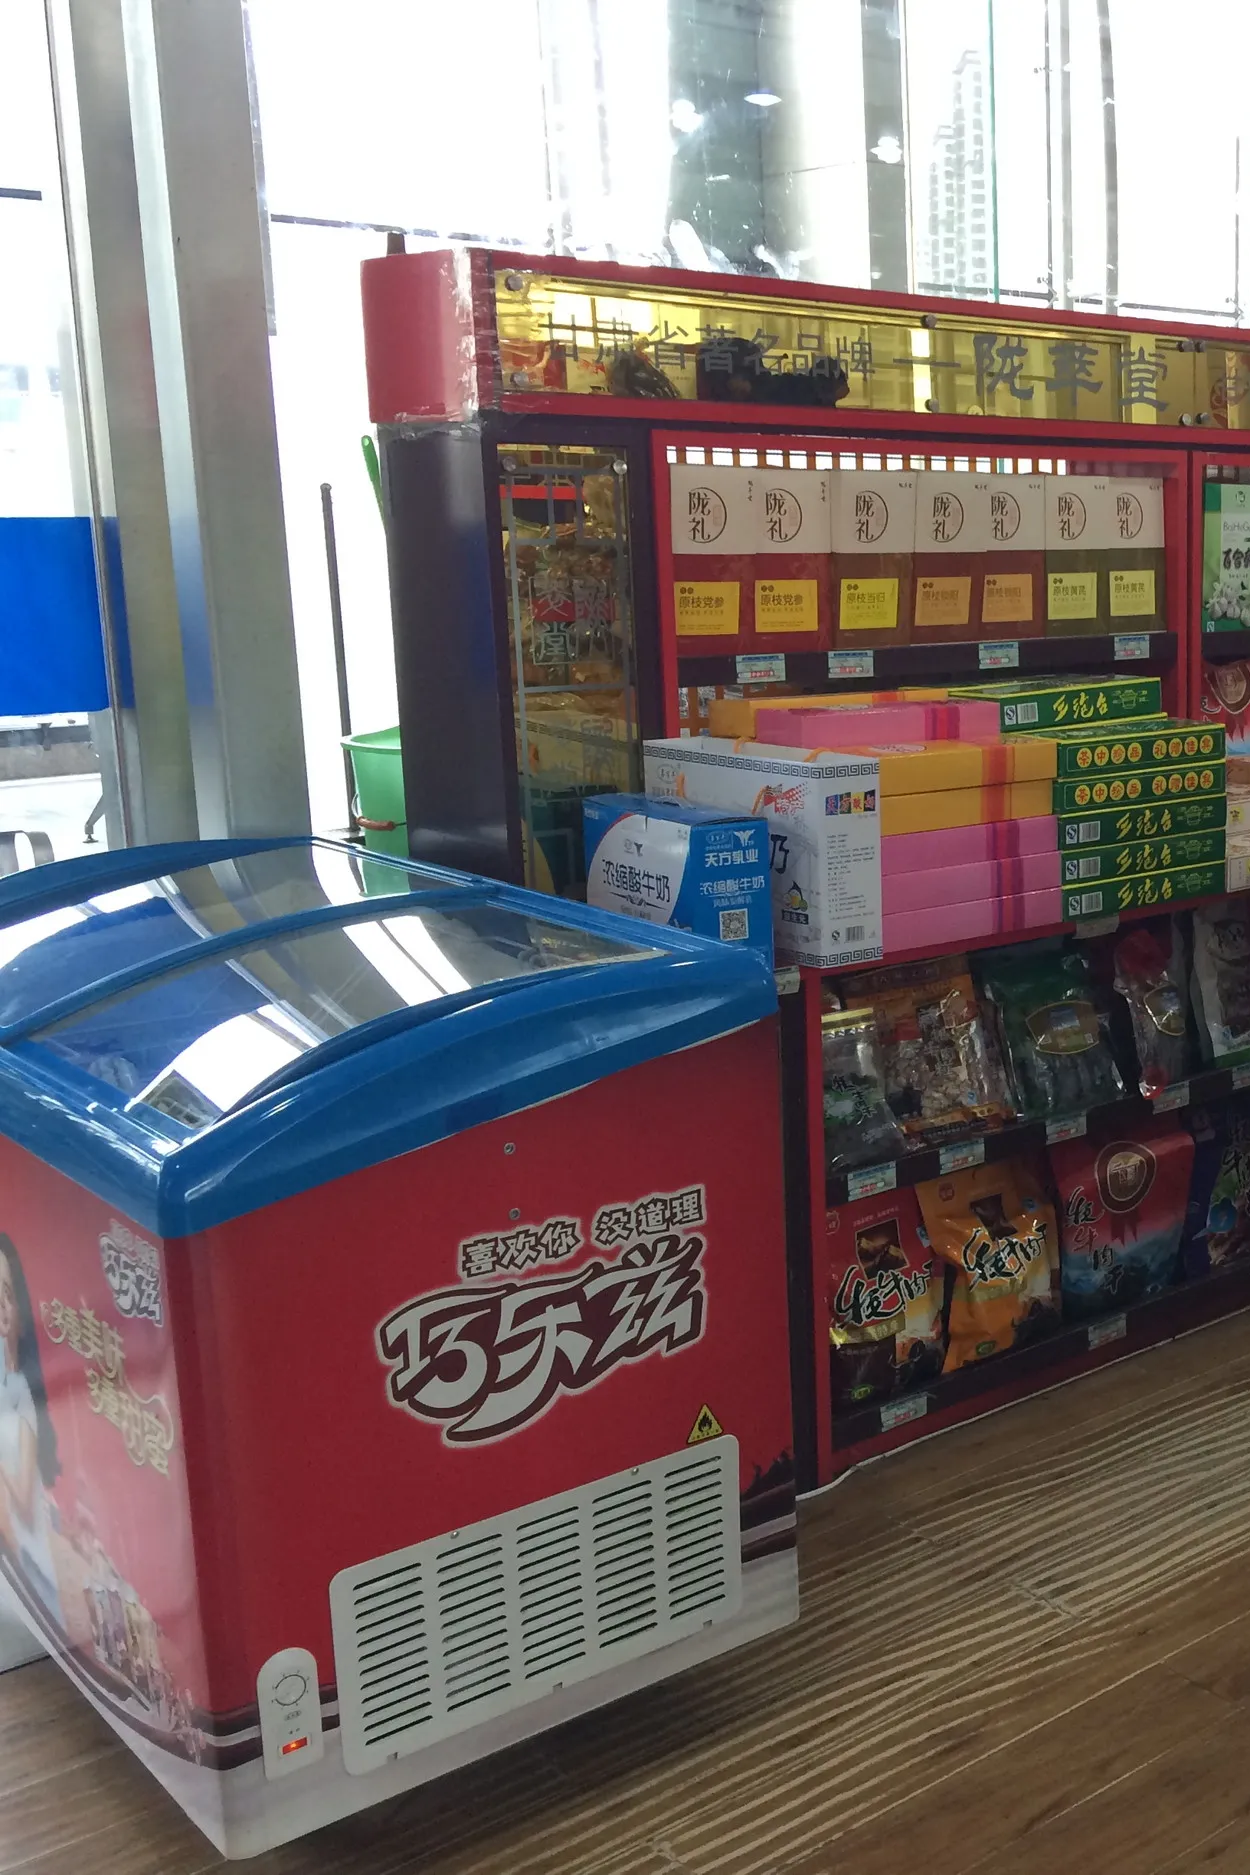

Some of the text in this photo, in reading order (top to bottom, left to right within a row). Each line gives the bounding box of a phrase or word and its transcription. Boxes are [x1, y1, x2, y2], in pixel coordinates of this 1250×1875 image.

[679, 596, 725, 609] 原枝党参
[760, 593, 804, 606] 原枝党参
[846, 592, 886, 604] 原枝当归
[705, 849, 758, 867] 天方乳业
[602, 859, 670, 903] 浓缩酸牛奶
[700, 876, 765, 895] 浓缩酸牛奶
[462, 1189, 703, 1278] 喜欢你 没道理
[380, 1234, 703, 1441] 巧乐兹
